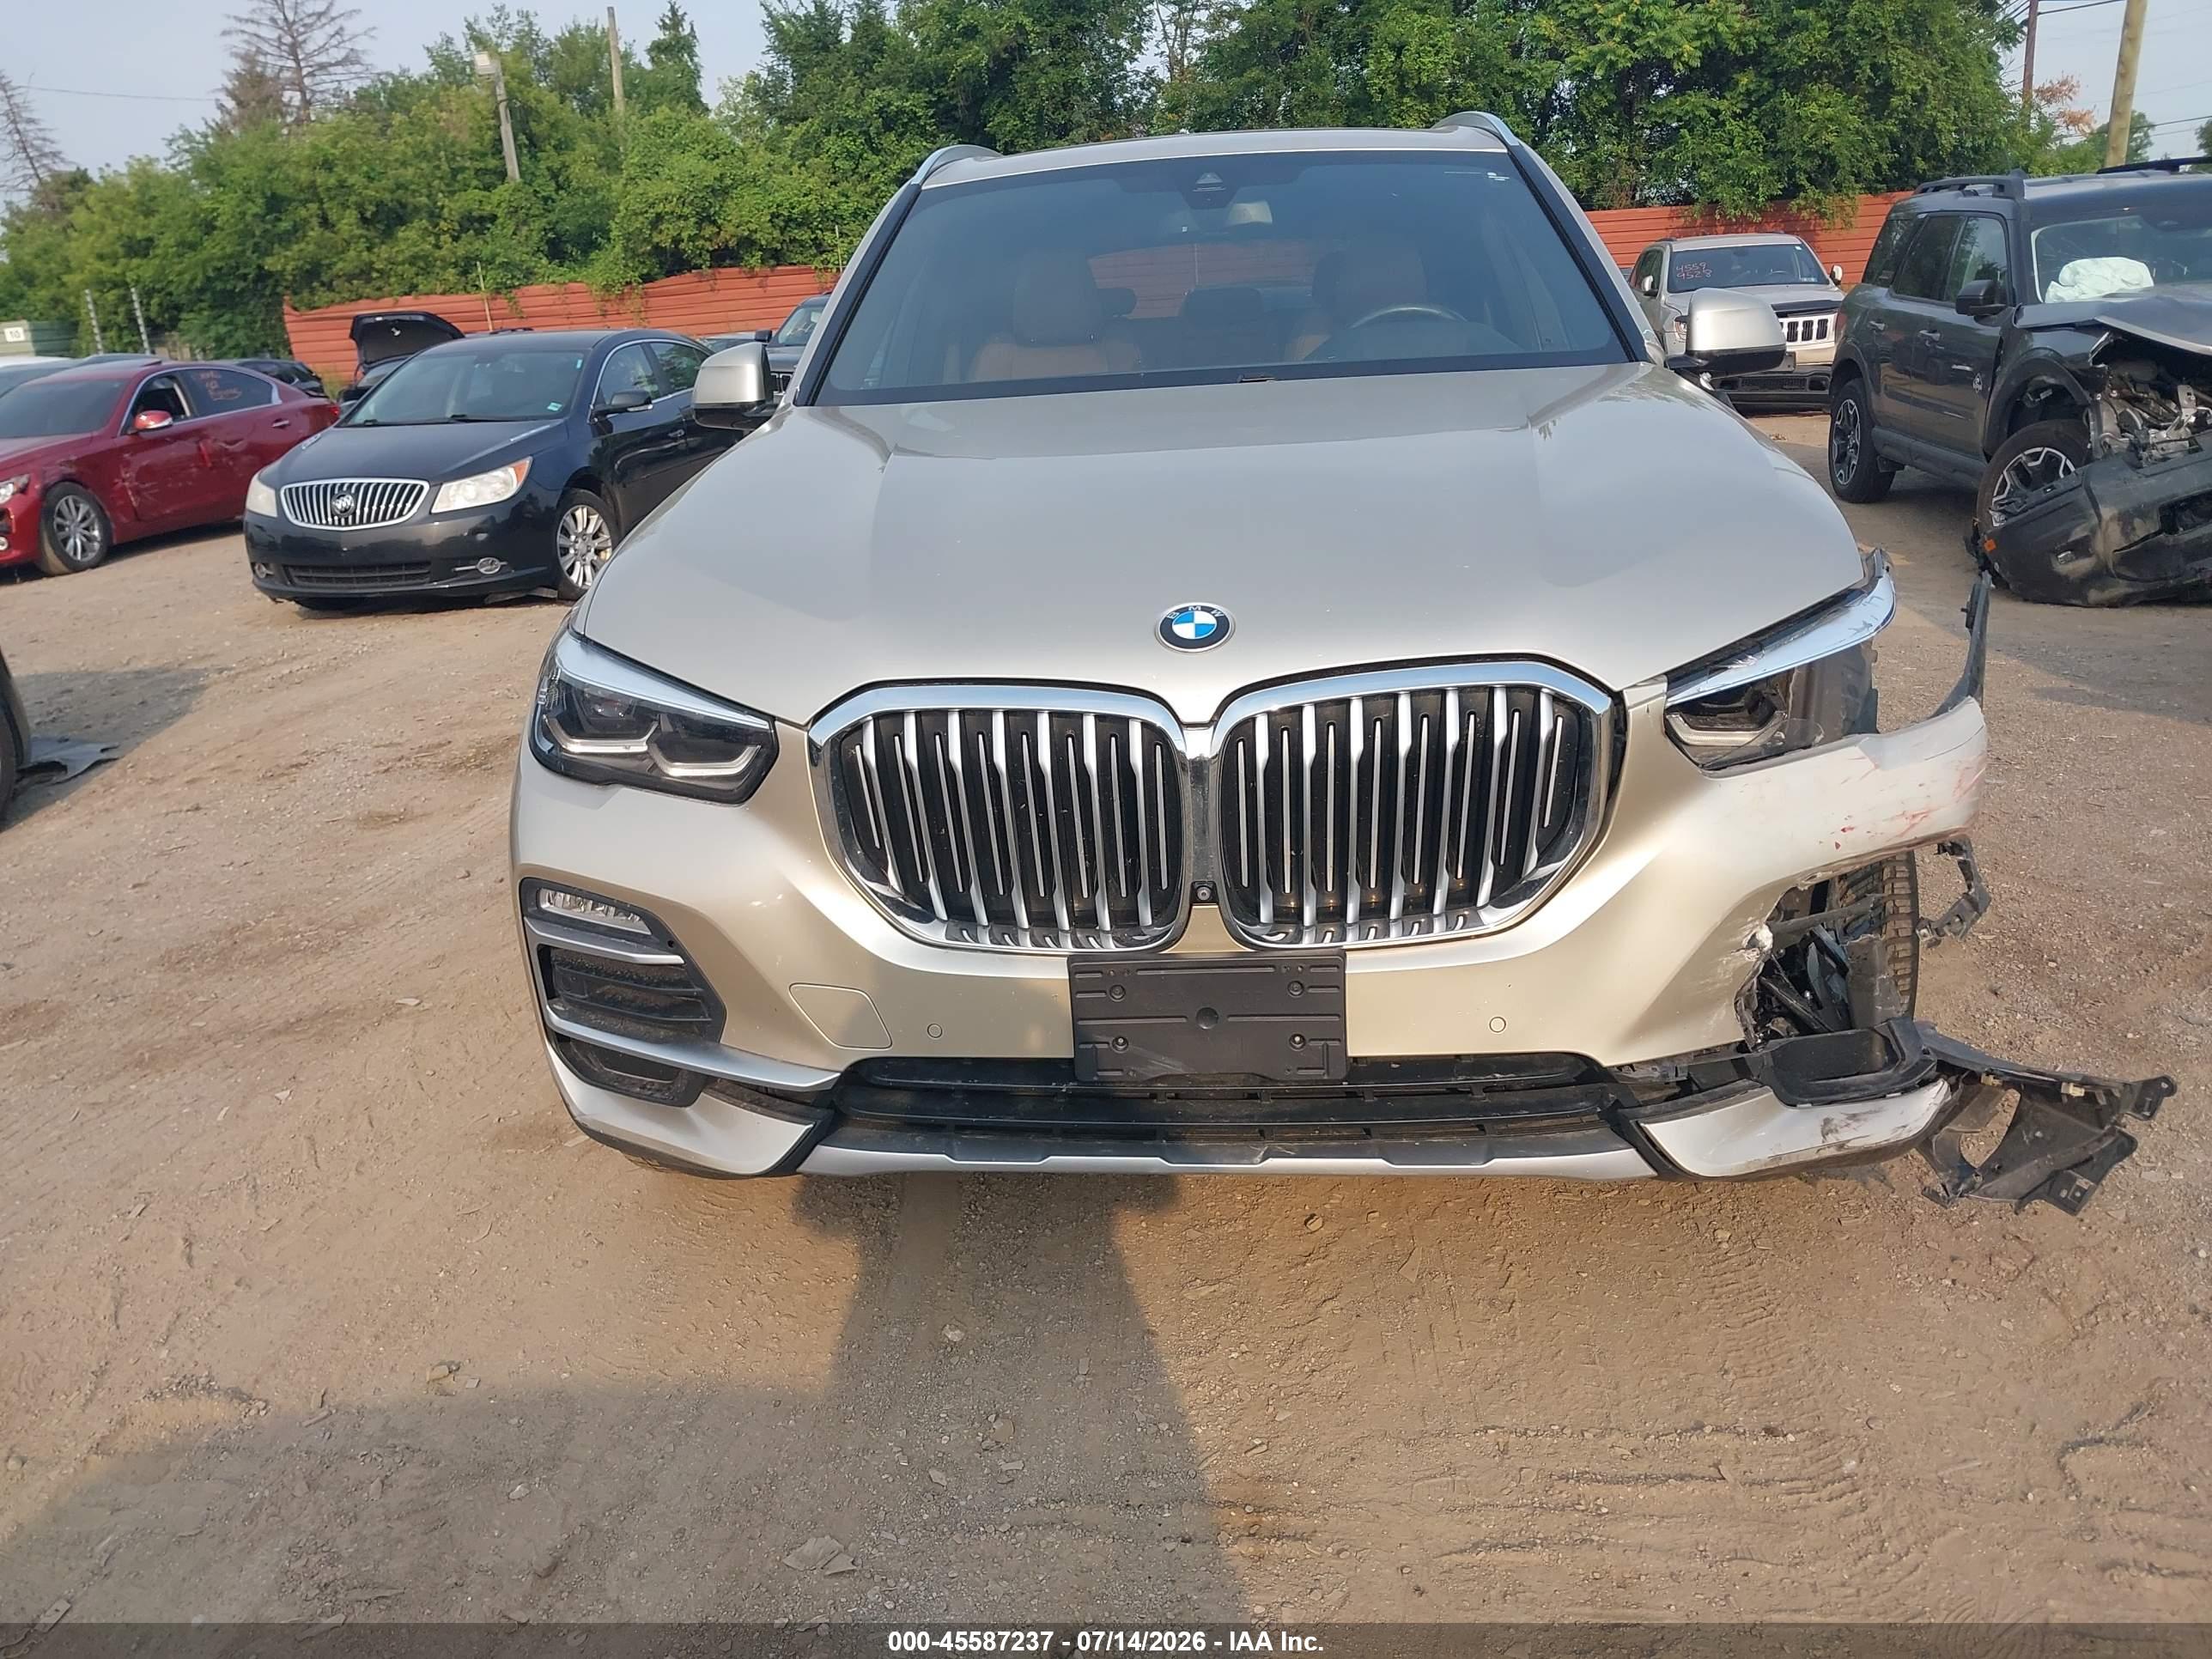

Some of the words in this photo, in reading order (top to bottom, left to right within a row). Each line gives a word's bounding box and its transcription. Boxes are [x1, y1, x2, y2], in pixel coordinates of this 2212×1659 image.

[1676, 261, 1706, 273] 4559
[1676, 269, 1713, 280] 9528
[1166, 605, 1224, 620] BMW
